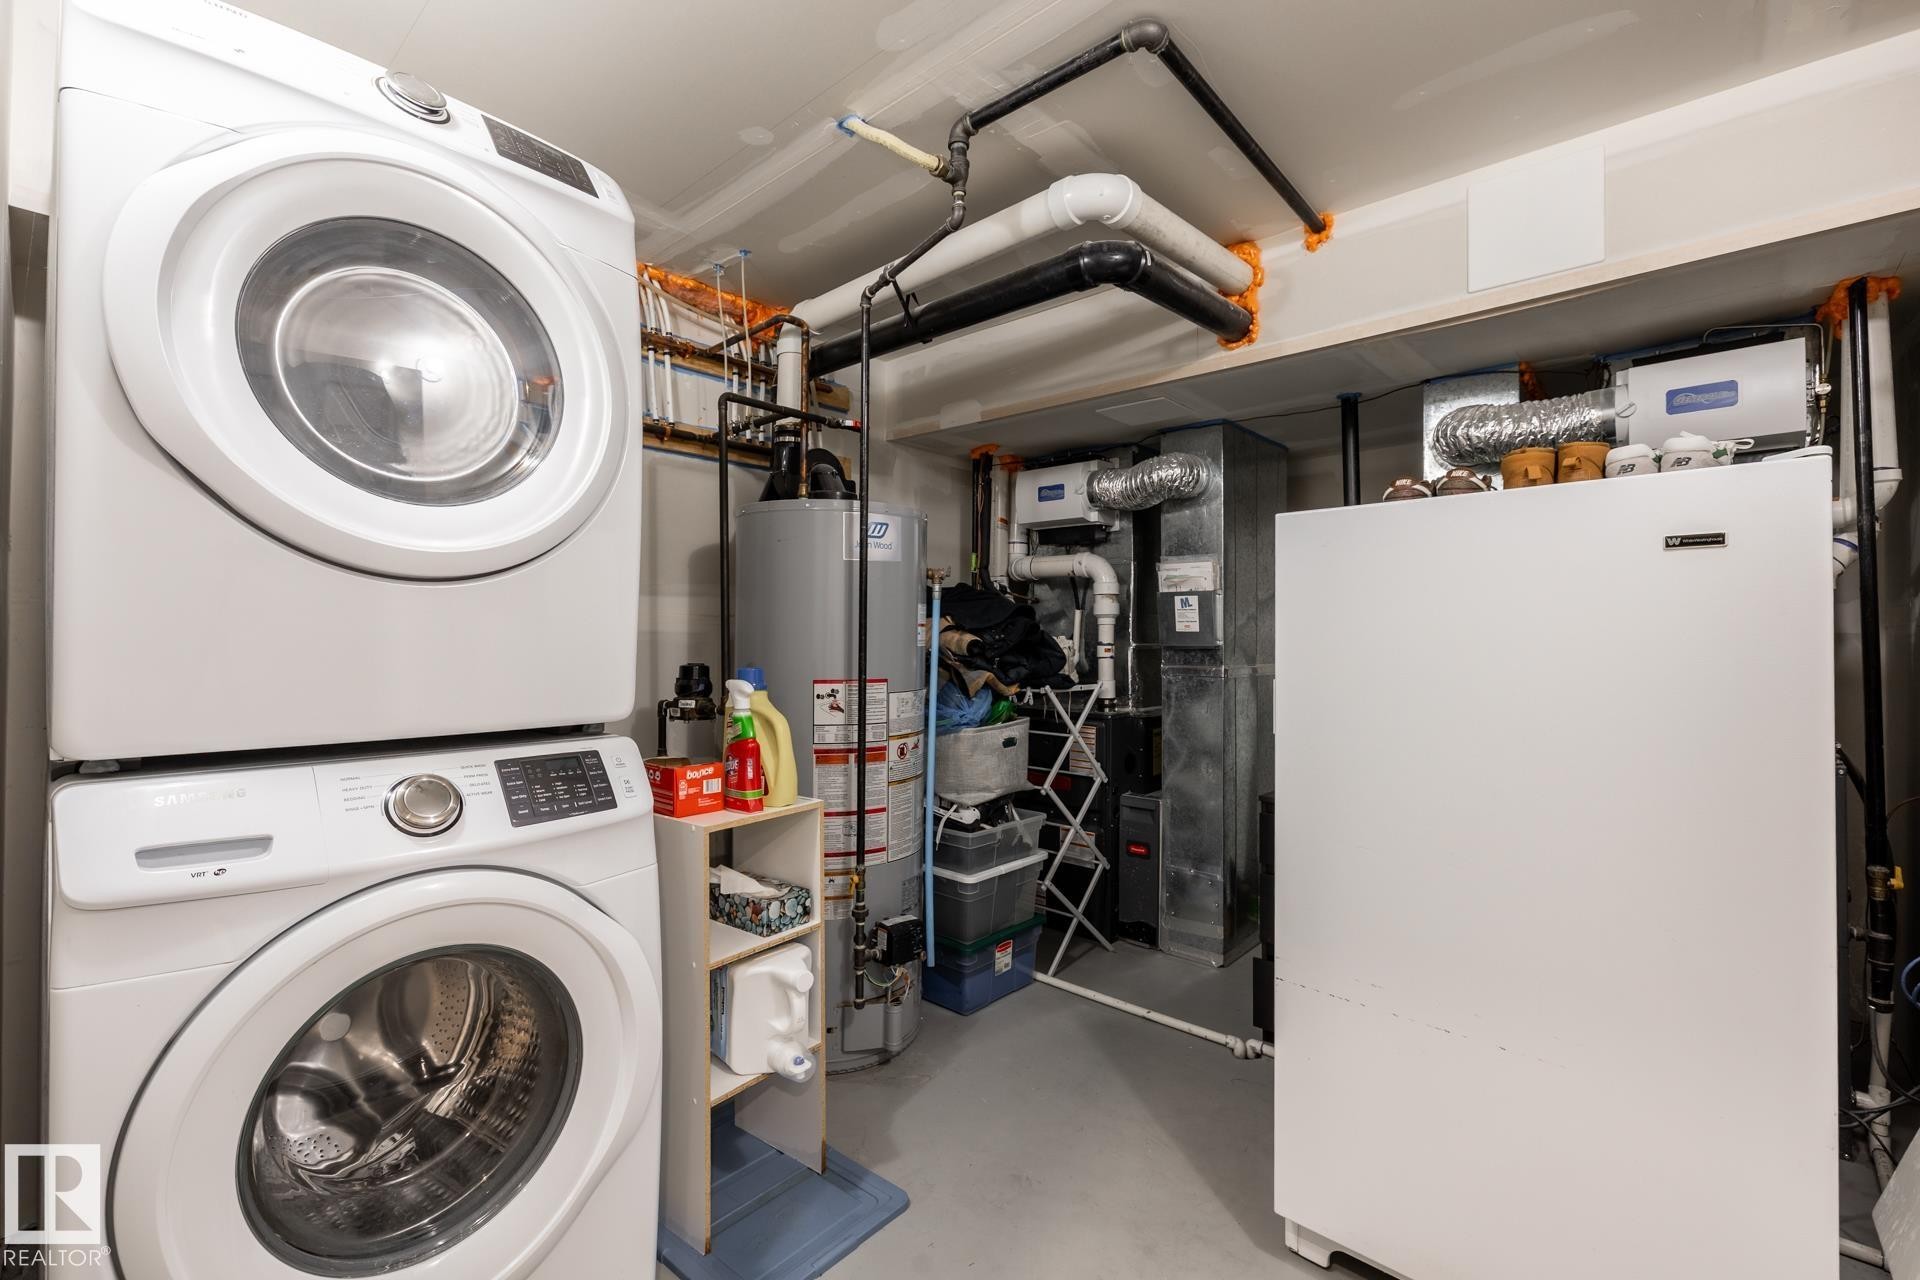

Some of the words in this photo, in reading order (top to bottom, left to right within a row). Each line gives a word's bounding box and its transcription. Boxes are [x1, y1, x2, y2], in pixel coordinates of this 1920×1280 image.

[1450, 469, 1470, 478] NIKE
[1394, 478, 1413, 486] NIKE
[873, 541, 893, 550] Wood
[686, 766, 714, 780] bounce
